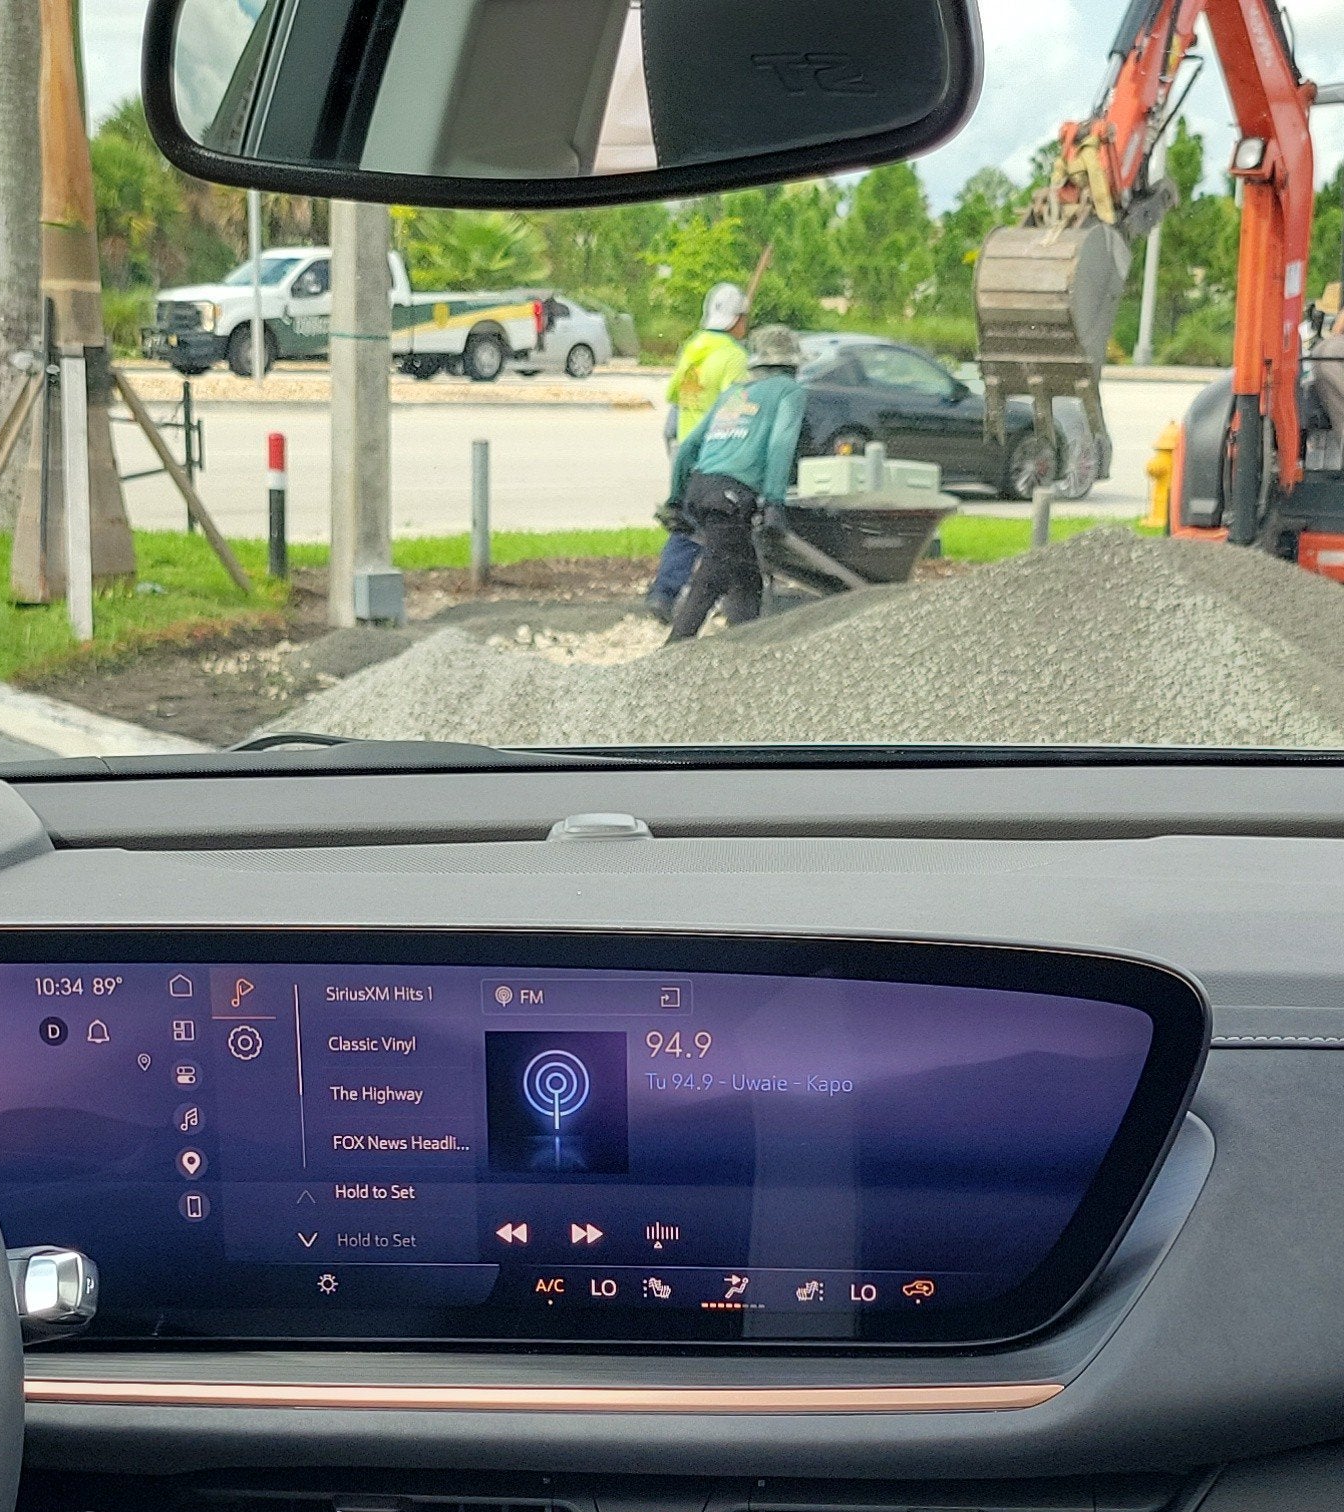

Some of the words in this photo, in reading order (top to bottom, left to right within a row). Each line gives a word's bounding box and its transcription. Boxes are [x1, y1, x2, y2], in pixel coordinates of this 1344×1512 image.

[35, 977, 84, 996] 10:34
[92, 975, 123, 995] 89°
[326, 986, 390, 1002] SiriusXM
[394, 986, 424, 1001] Hits
[427, 986, 433, 1001] 1
[520, 990, 544, 1004] FM
[48, 1025, 60, 1038] D
[328, 1036, 379, 1051] Classic
[381, 1036, 416, 1055] Vinyl
[645, 1030, 713, 1060] 94.9
[645, 1072, 666, 1091] Tu
[671, 1073, 714, 1092] 94.9
[732, 1073, 788, 1092] Uwaie
[806, 1074, 853, 1096] Kapo
[330, 1086, 358, 1101] The
[362, 1086, 424, 1105] Highway
[333, 1135, 365, 1150] FOX
[367, 1135, 408, 1150] News
[410, 1135, 470, 1151] Headli...
[335, 1184, 369, 1199] Hold
[372, 1186, 386, 1199] to
[390, 1184, 415, 1199] Set
[337, 1233, 371, 1248] Hold
[374, 1235, 388, 1248] to
[392, 1233, 416, 1248] Set
[535, 1278, 564, 1294] A/C
[591, 1280, 617, 1297] LO
[851, 1283, 876, 1301] LO
